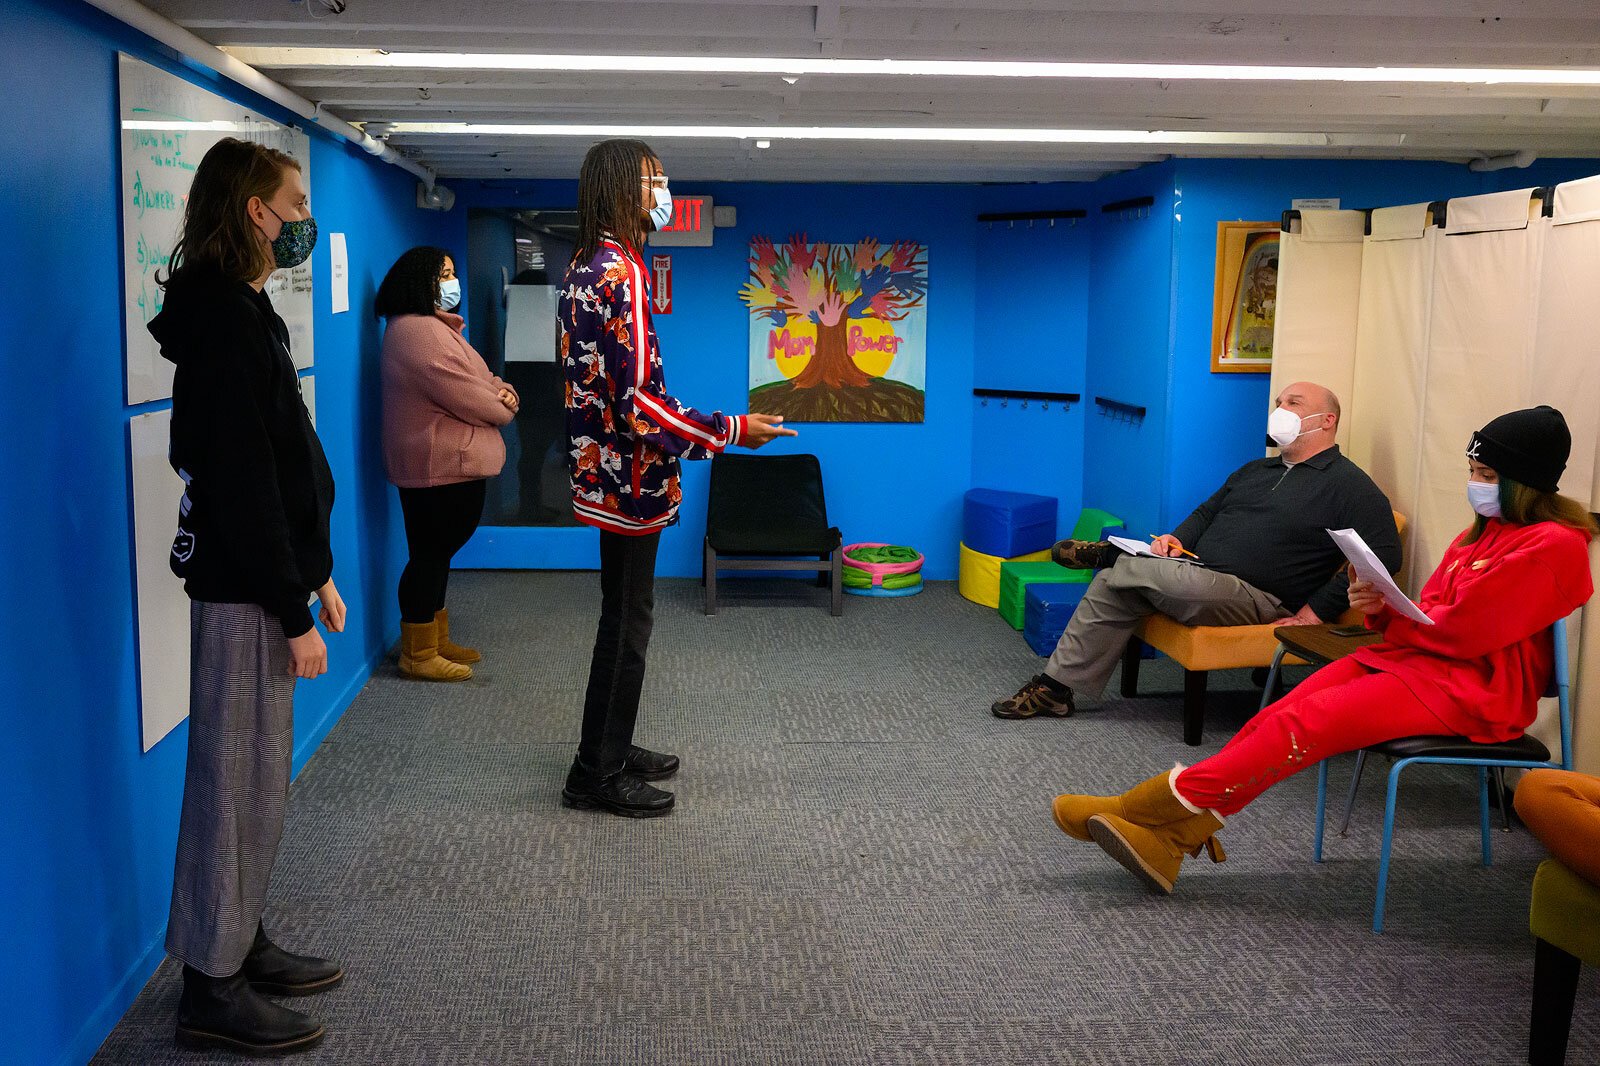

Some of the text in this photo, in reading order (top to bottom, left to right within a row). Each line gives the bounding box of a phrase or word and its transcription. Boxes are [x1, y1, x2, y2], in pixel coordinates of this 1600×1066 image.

[655, 260, 669, 269] FIRE
[768, 325, 904, 360] Mom Power
